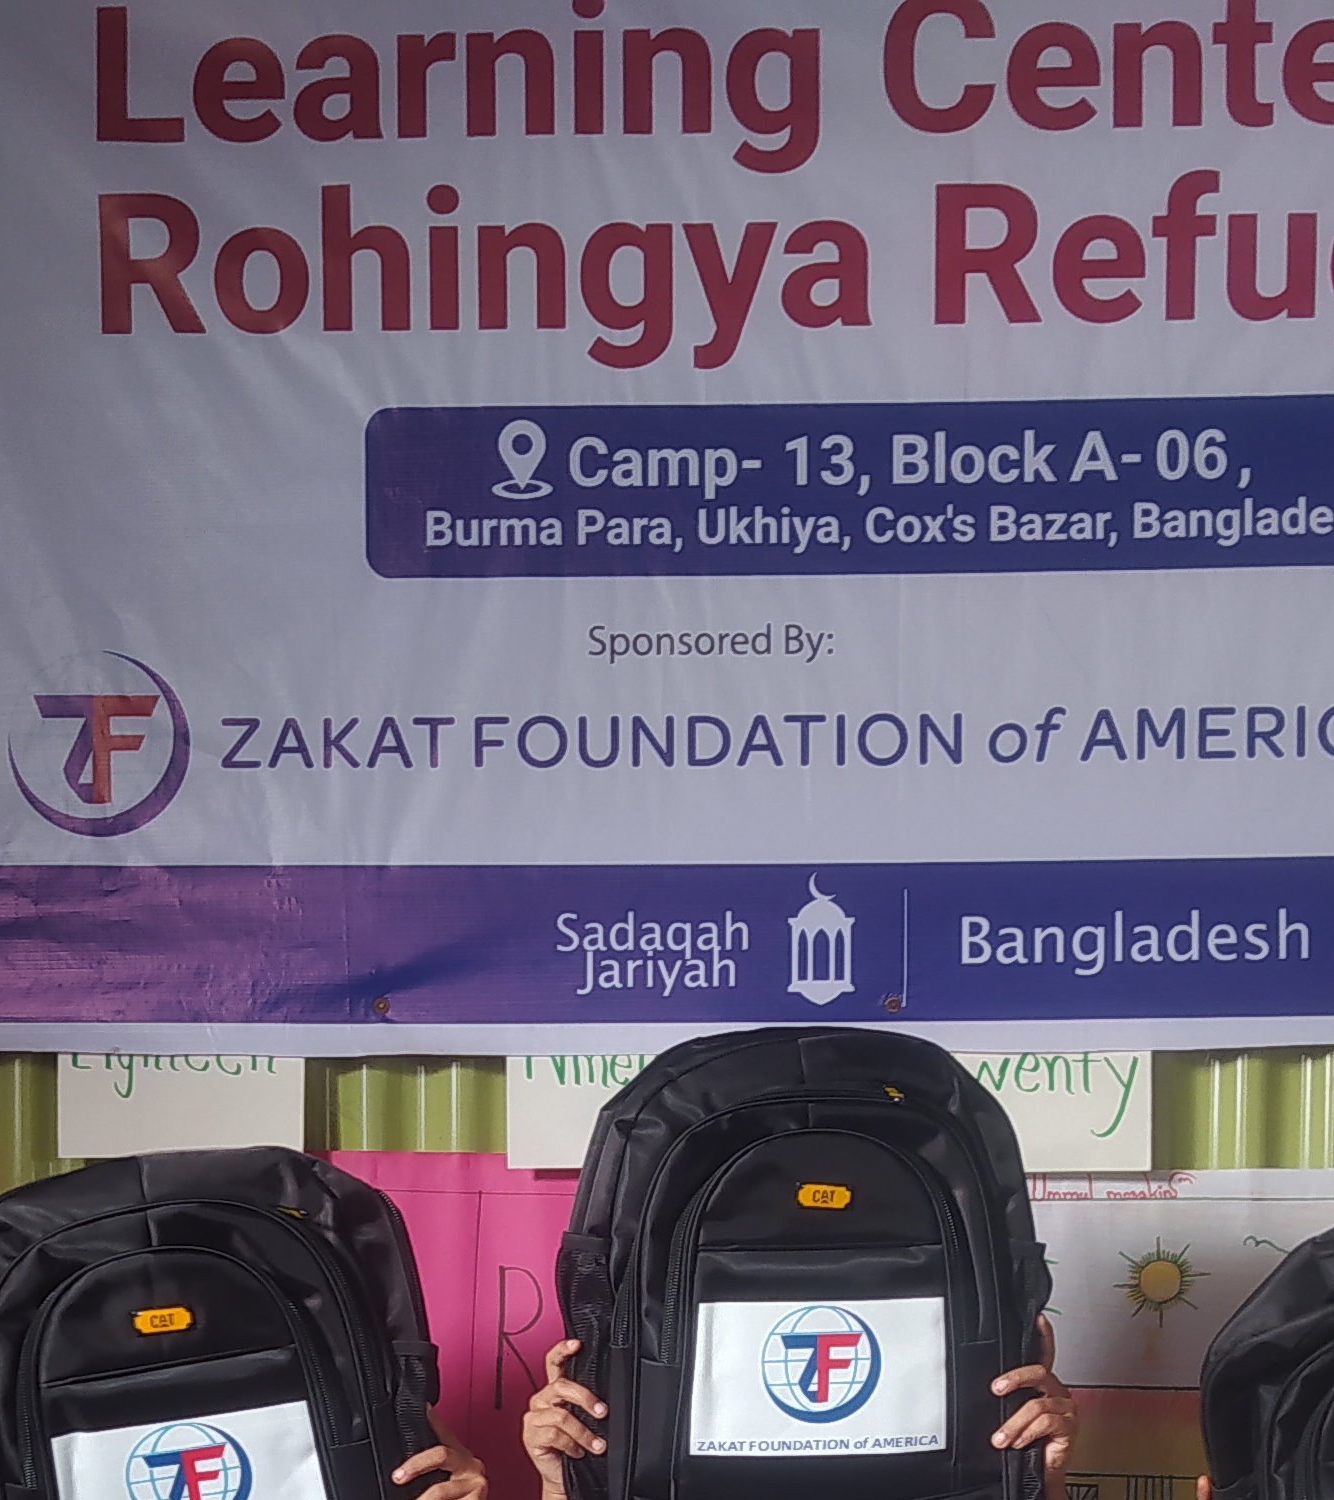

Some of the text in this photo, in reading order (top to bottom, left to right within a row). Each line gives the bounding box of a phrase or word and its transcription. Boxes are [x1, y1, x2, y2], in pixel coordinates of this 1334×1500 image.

[96, 0, 821, 173] Learning
[98, 184, 872, 369] Rohingya
[570, 435, 762, 497] Camp-
[786, 436, 870, 494] 13,
[892, 430, 1056, 484] Block
[425, 510, 562, 548] Burma
[577, 508, 684, 552] Para,
[698, 506, 851, 553] Ukhiya,
[865, 504, 975, 546] Cox's
[989, 505, 1119, 547] Bazar,
[588, 625, 834, 663] Sponsored By:
[221, 716, 455, 769] ZAKAT
[475, 712, 962, 769] FOUNDATION
[987, 706, 1065, 763] of
[555, 910, 748, 958] Sadaqah
[960, 908, 1310, 974] Bangladesh
[578, 953, 737, 997] Jariyah
[150, 1313, 175, 1328] CAT
[697, 1434, 939, 1451] ZAKAT FOUNDATION of AMERICA
